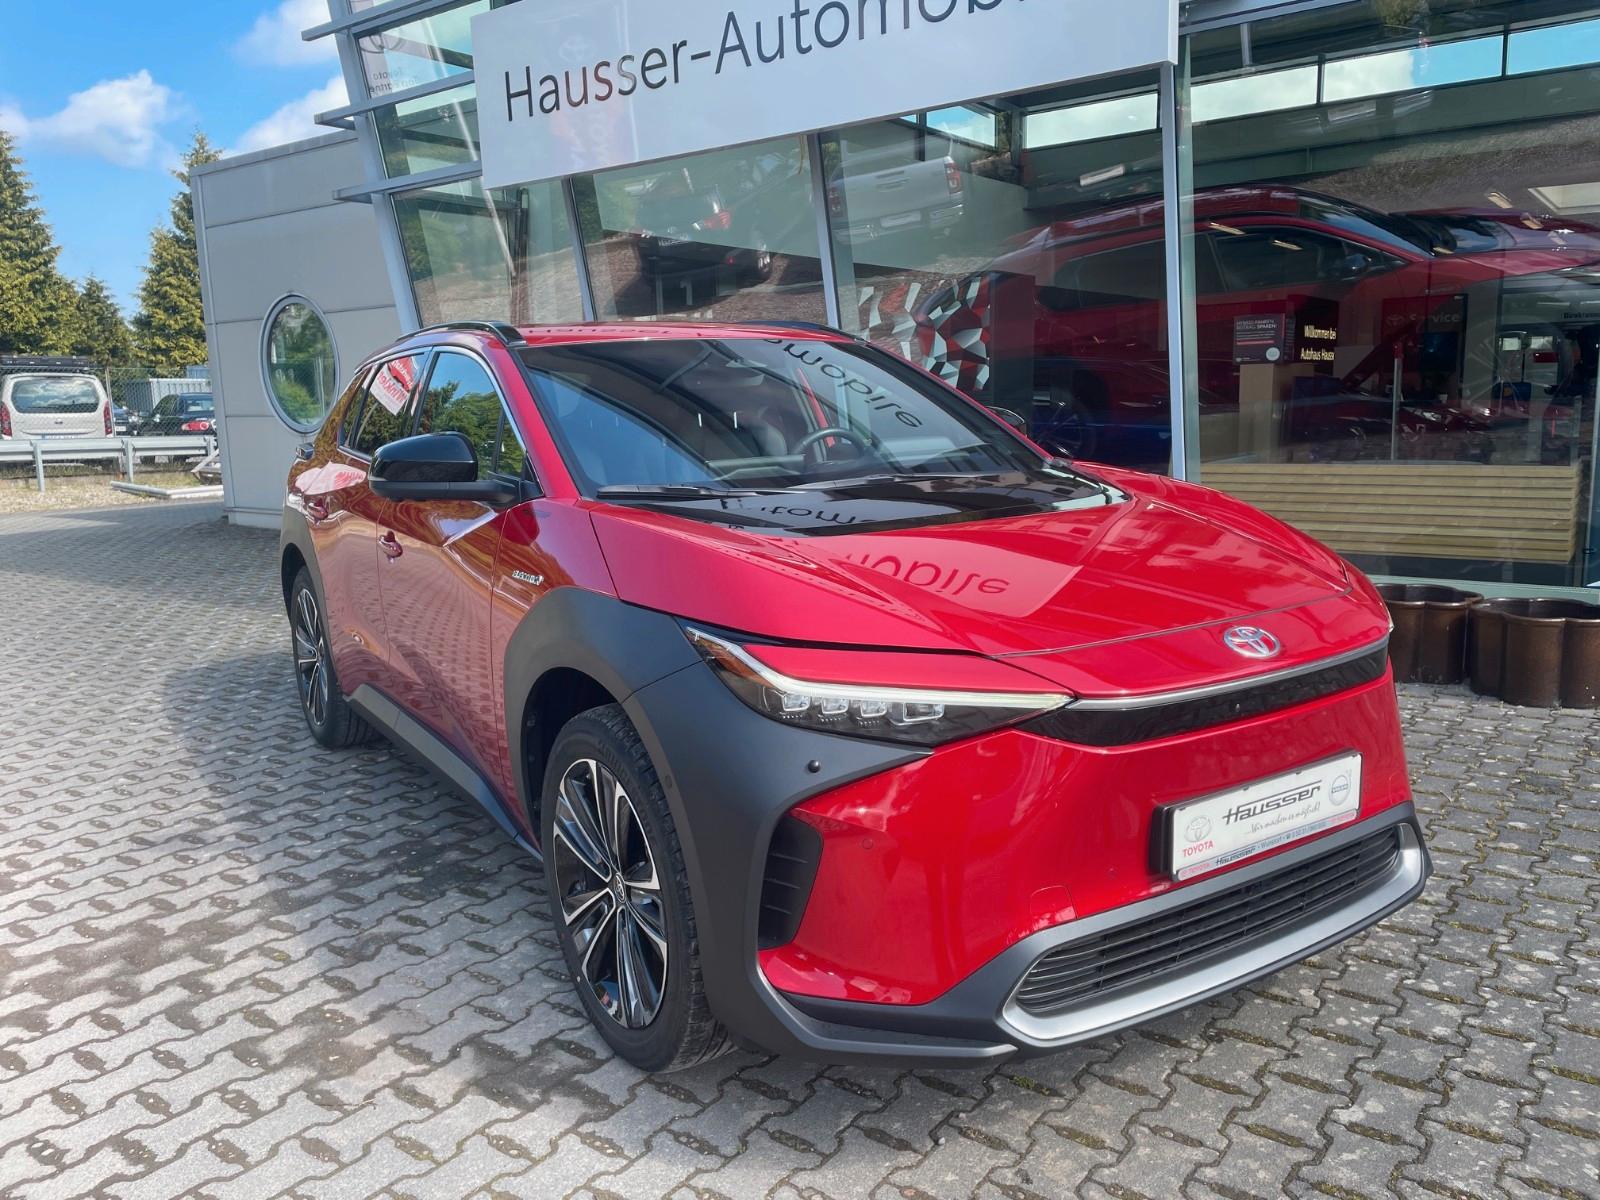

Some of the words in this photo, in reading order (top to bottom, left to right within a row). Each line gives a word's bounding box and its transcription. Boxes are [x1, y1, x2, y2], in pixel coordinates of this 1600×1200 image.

[505, 0, 1022, 122] Hausser-Automo
[1222, 779, 1322, 826] Hausser
[1182, 840, 1214, 858] TOYOTA
